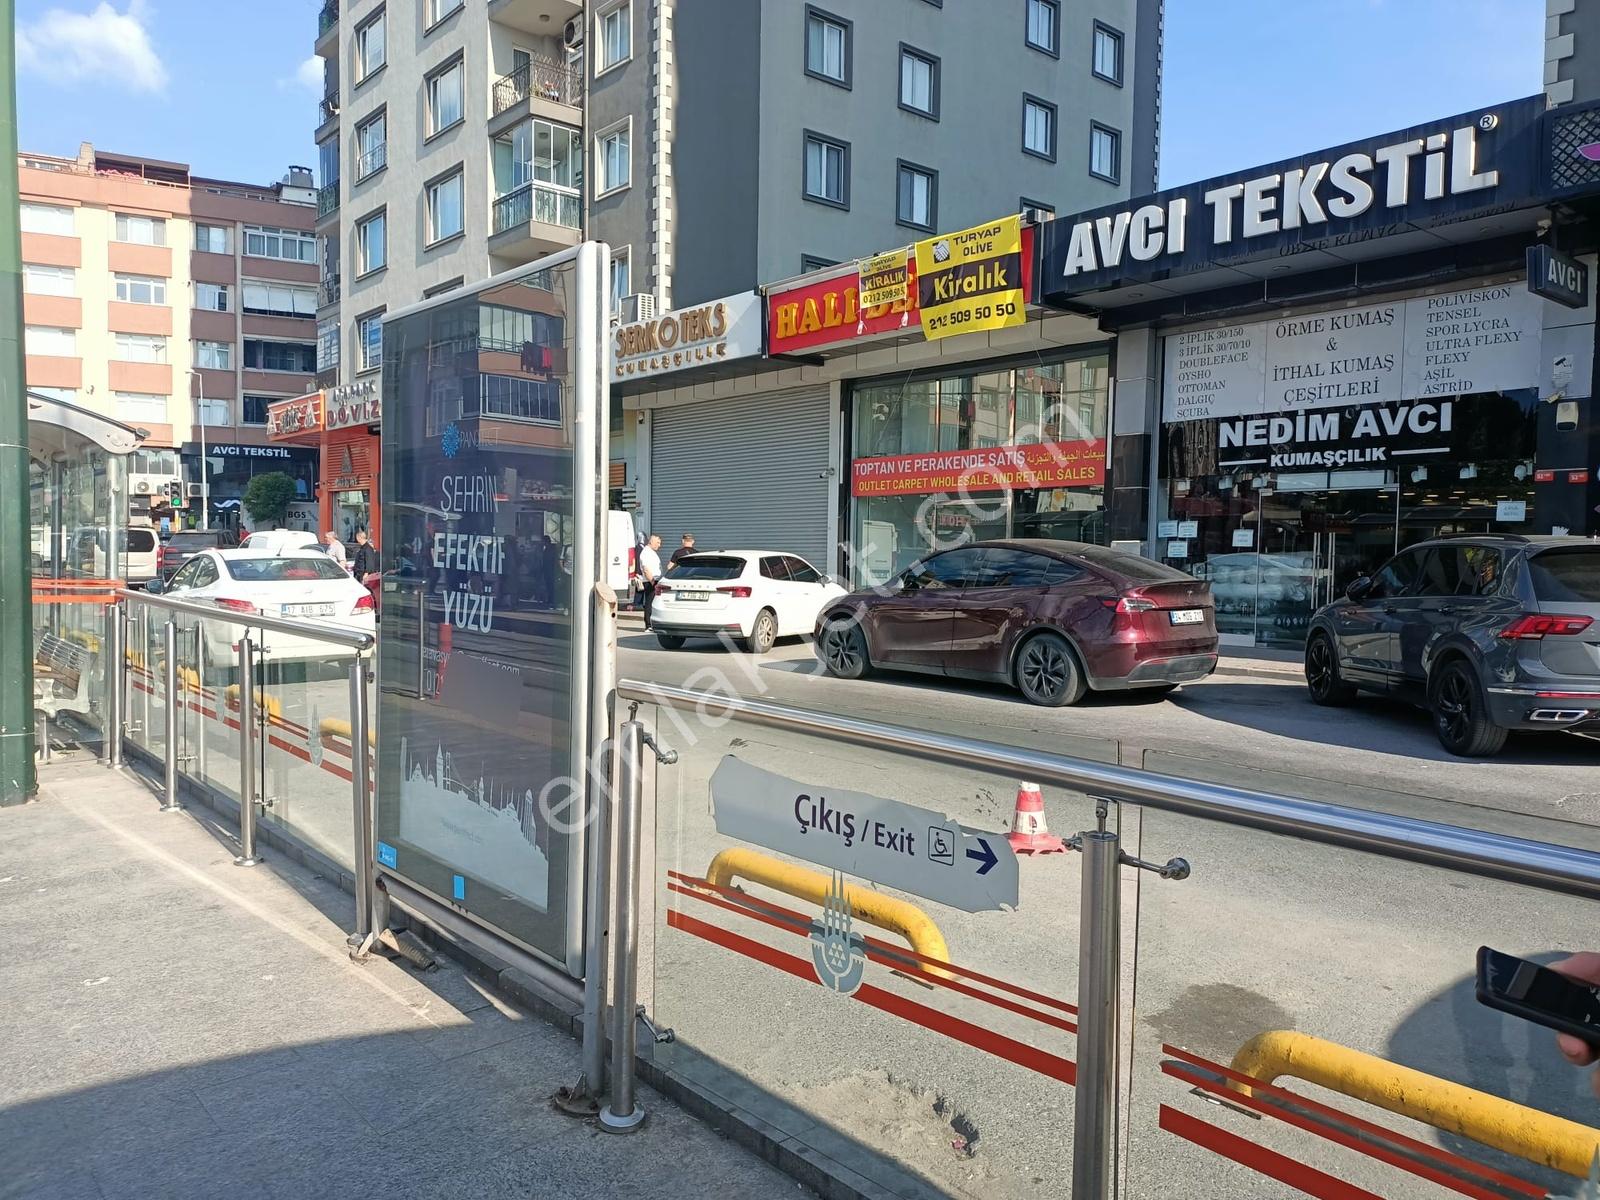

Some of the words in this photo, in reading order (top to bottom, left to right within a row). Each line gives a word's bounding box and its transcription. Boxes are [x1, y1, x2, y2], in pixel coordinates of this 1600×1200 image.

[953, 226, 1001, 244] TURYAP
[1063, 198, 1186, 276] AVCI
[963, 241, 993, 257] OLİVE
[865, 270, 904, 290] KİRALIK
[934, 261, 1007, 301] Kiralık
[1548, 258, 1581, 294] AVCI
[1428, 287, 1511, 309] POLİVİSKON
[775, 287, 858, 339] HALI
[950, 309, 971, 324] 509
[974, 306, 991, 320] 50
[995, 302, 1016, 317] 50
[1275, 321, 1325, 339] ÖRME
[1330, 308, 1394, 331] KUMAŞ
[1426, 307, 1481, 323] TENSEL
[1187, 331, 1215, 344] İPLİK
[1426, 324, 1460, 338] SPOR
[1464, 317, 1510, 333] LYCRA
[1186, 343, 1214, 356] İPLİK
[1326, 337, 1338, 351] &
[1426, 337, 1471, 352] ULTRA
[1474, 330, 1522, 347] FLEXY
[1179, 352, 1249, 370] DOUBLEFACE
[1272, 363, 1325, 382] İTHAL
[1330, 353, 1394, 375] KUMAŞ
[1425, 351, 1471, 366] FLEXY
[1178, 369, 1212, 382] OYSHO
[1424, 366, 1455, 381] AŞİL
[1178, 380, 1226, 394] OTTOMAN
[1283, 376, 1380, 406] ÇEŞİTLERİ
[1424, 379, 1473, 395] ASTRİD
[1177, 393, 1216, 406] DALGIÇ
[327, 396, 381, 427] DÖVİZ
[1176, 407, 1210, 418] SCUBA
[1219, 409, 1340, 448] NEDİM
[1351, 402, 1453, 439] AVCI
[212, 446, 239, 455] AVCI
[243, 447, 291, 458] TEKSTİL
[1270, 446, 1387, 468] KUMAŞÇILIK
[854, 461, 895, 477] TOPTAN
[897, 460, 912, 473] VE
[914, 454, 985, 472] PERAKENDE
[988, 450, 1026, 468] SATIŞ
[858, 480, 892, 492] OUTLET
[893, 477, 928, 491] CARPET
[930, 474, 989, 488] WHOLESALE
[991, 473, 1014, 485] AND
[1015, 470, 1054, 483] RETAIL
[1056, 467, 1096, 481] SALES
[440, 467, 499, 521] ŞEHRİN
[287, 511, 306, 519] BGS
[432, 527, 506, 575] EFEKTİF
[442, 582, 494, 634] YÜZÜ
[794, 794, 855, 847] Çıkış
[874, 822, 915, 857] Exit
